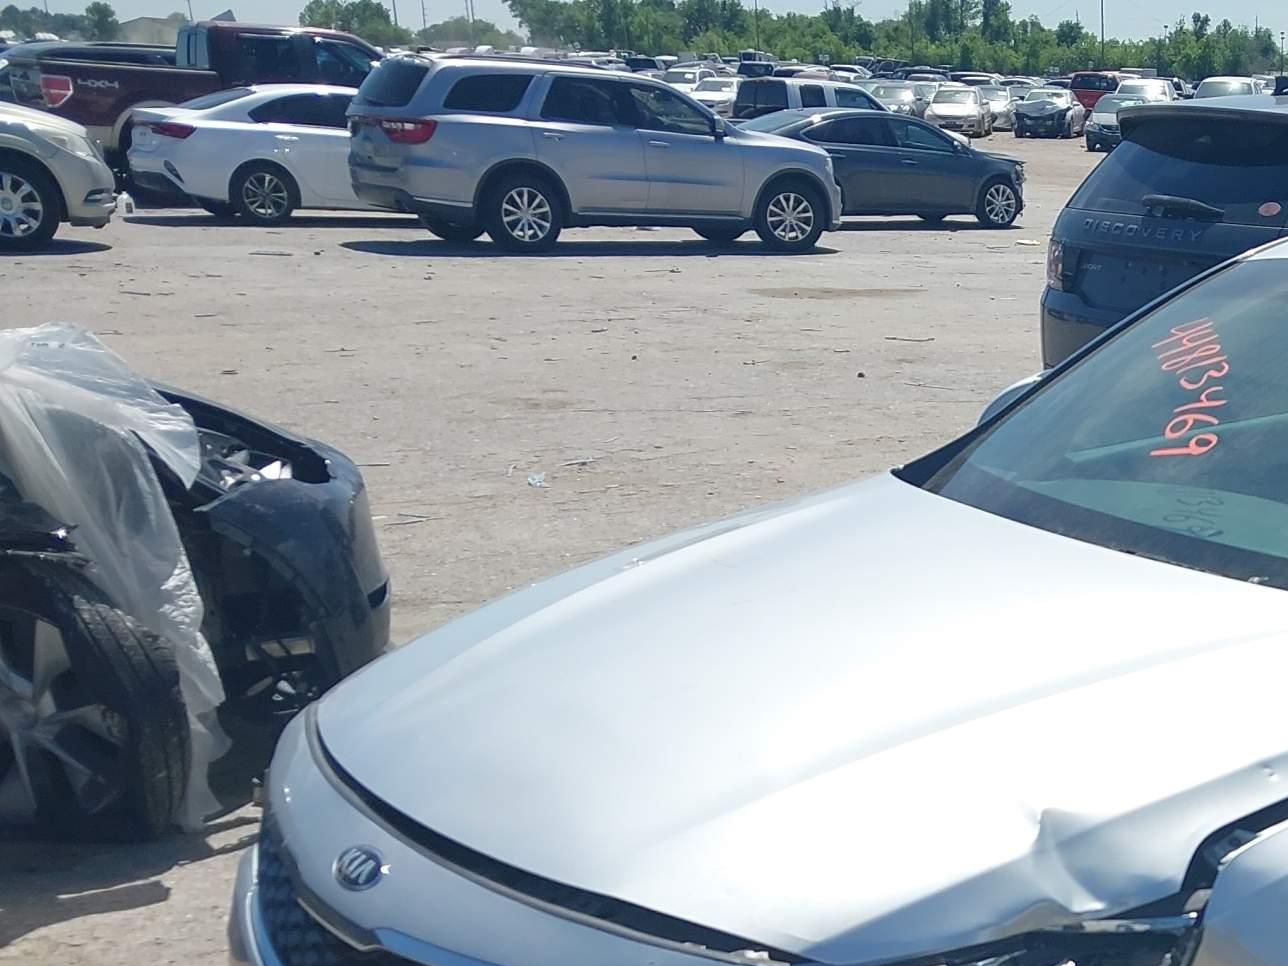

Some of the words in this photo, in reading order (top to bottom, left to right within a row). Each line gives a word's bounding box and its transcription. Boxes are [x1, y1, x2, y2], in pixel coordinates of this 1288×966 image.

[1083, 217, 1201, 241] DISCOVERY
[1150, 316, 1230, 457] 44813469
[341, 847, 378, 885] KIA
